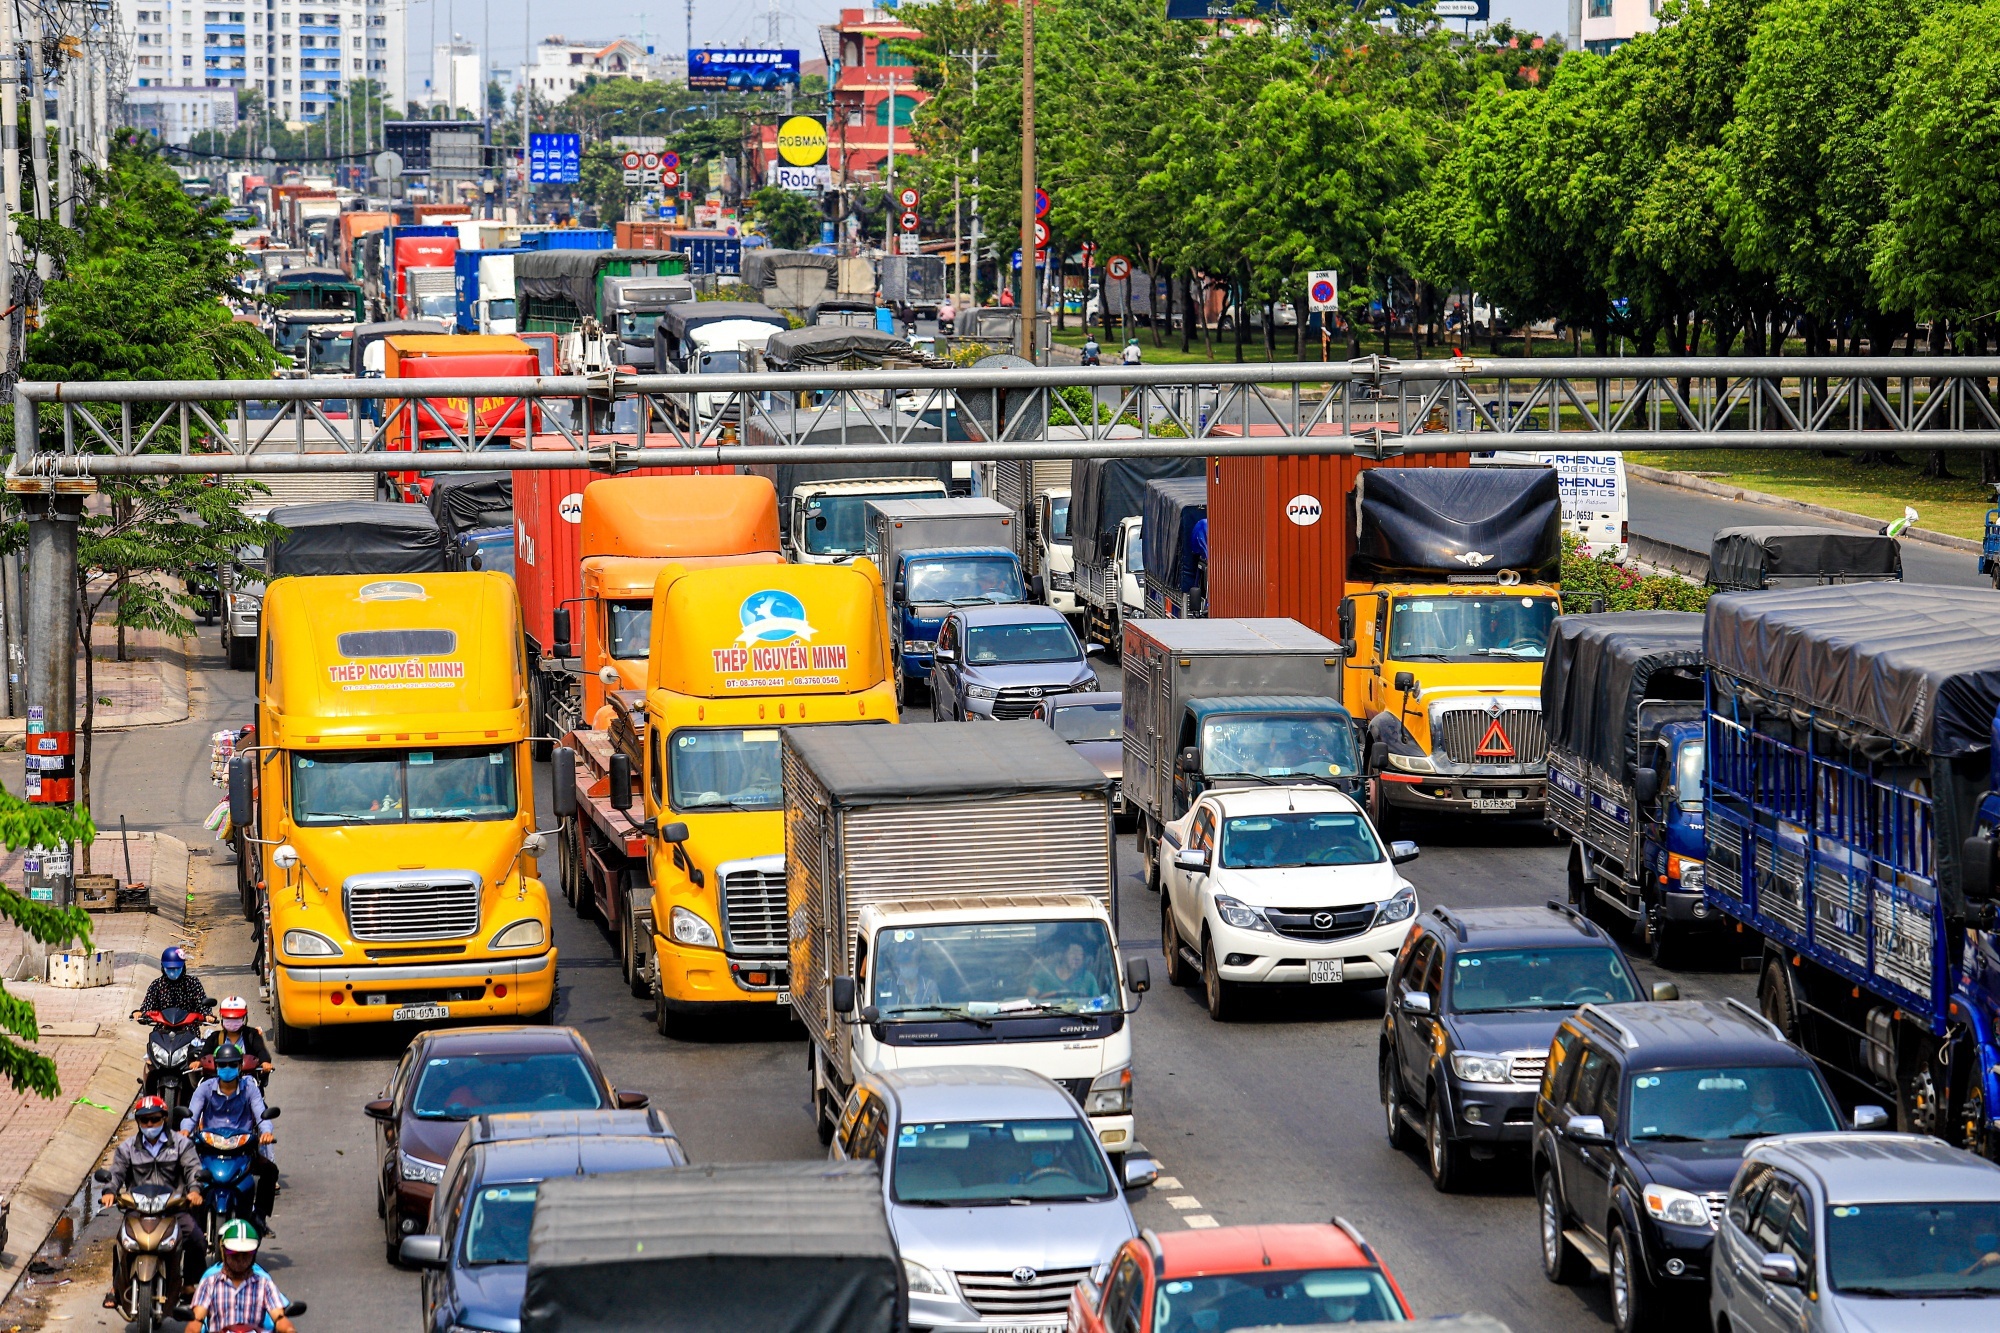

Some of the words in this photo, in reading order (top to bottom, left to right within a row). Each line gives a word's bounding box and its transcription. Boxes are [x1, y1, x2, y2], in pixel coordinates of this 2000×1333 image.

[711, 53, 783, 63] SAILUN
[779, 136, 825, 146] ROBMAN
[1556, 455, 1616, 466] RHENUS
[1290, 506, 1320, 516] PAN
[712, 644, 748, 672] THÉP
[753, 640, 808, 670] NGUYỄN
[812, 646, 846, 668] MINH
[330, 662, 365, 681] THÉP
[370, 658, 424, 680] NGUYỄN
[428, 662, 464, 678] MINH
[1318, 960, 1334, 970] 70C
[1312, 971, 1342, 982] 090.25
